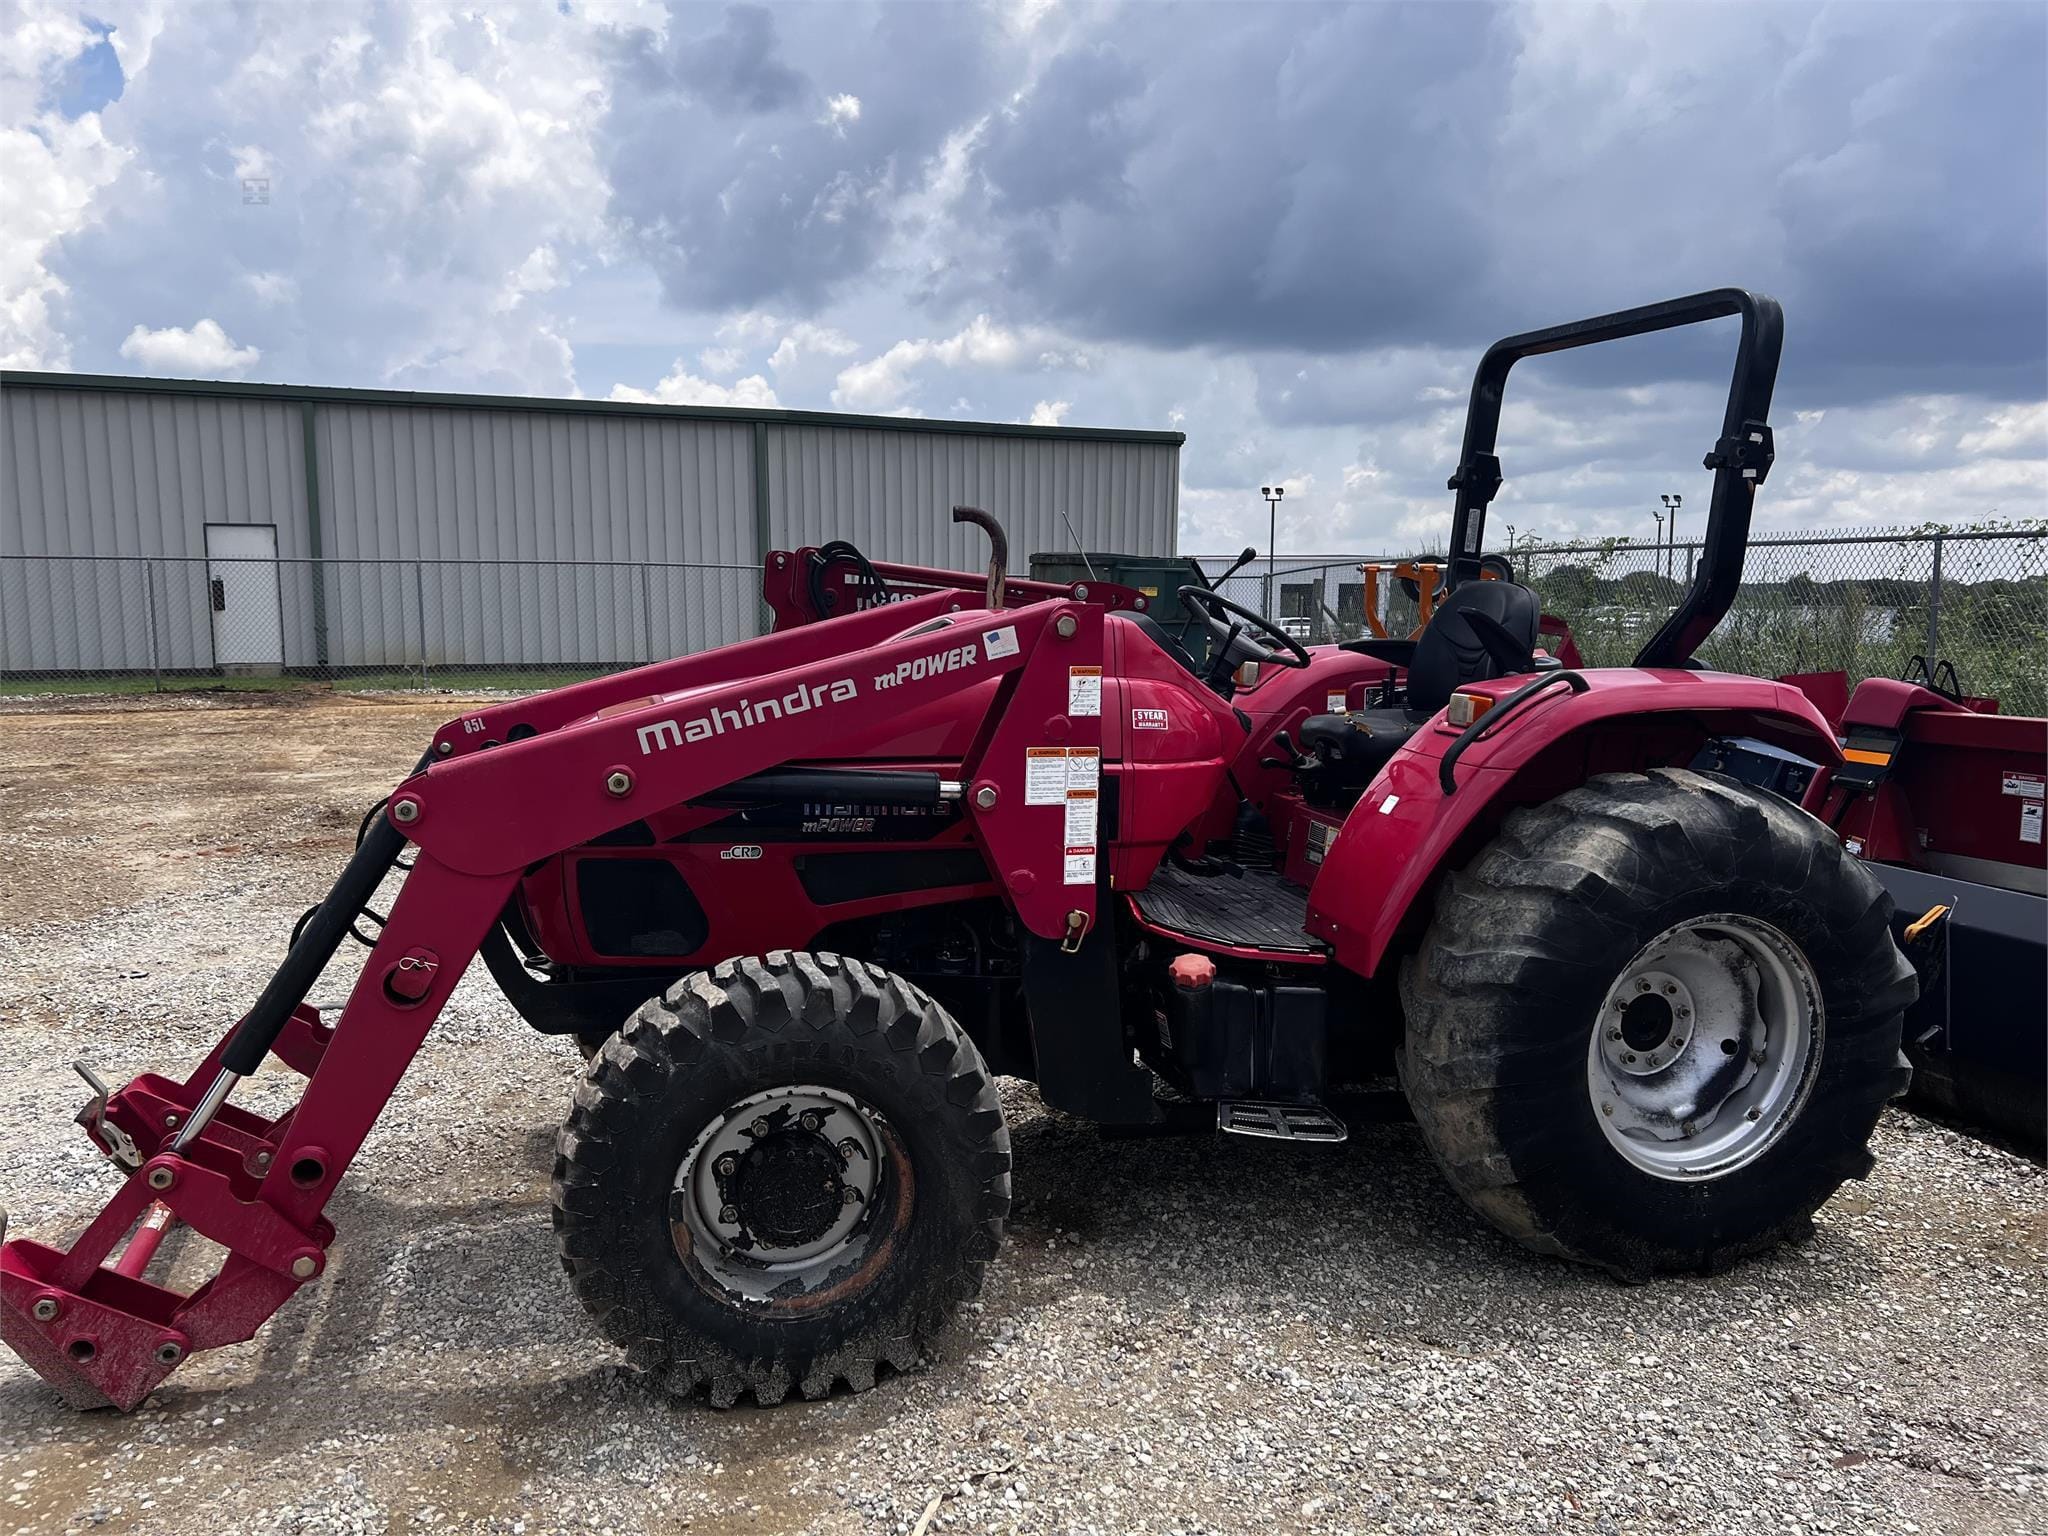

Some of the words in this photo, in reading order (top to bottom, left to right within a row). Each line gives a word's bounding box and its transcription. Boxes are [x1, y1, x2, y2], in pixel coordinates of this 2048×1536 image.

[873, 644, 977, 691] mPOWER
[636, 678, 858, 755] Mahindra
[1137, 711, 1143, 720] 5
[1143, 711, 1164, 720] YEAR
[802, 817, 875, 833] mPOWER
